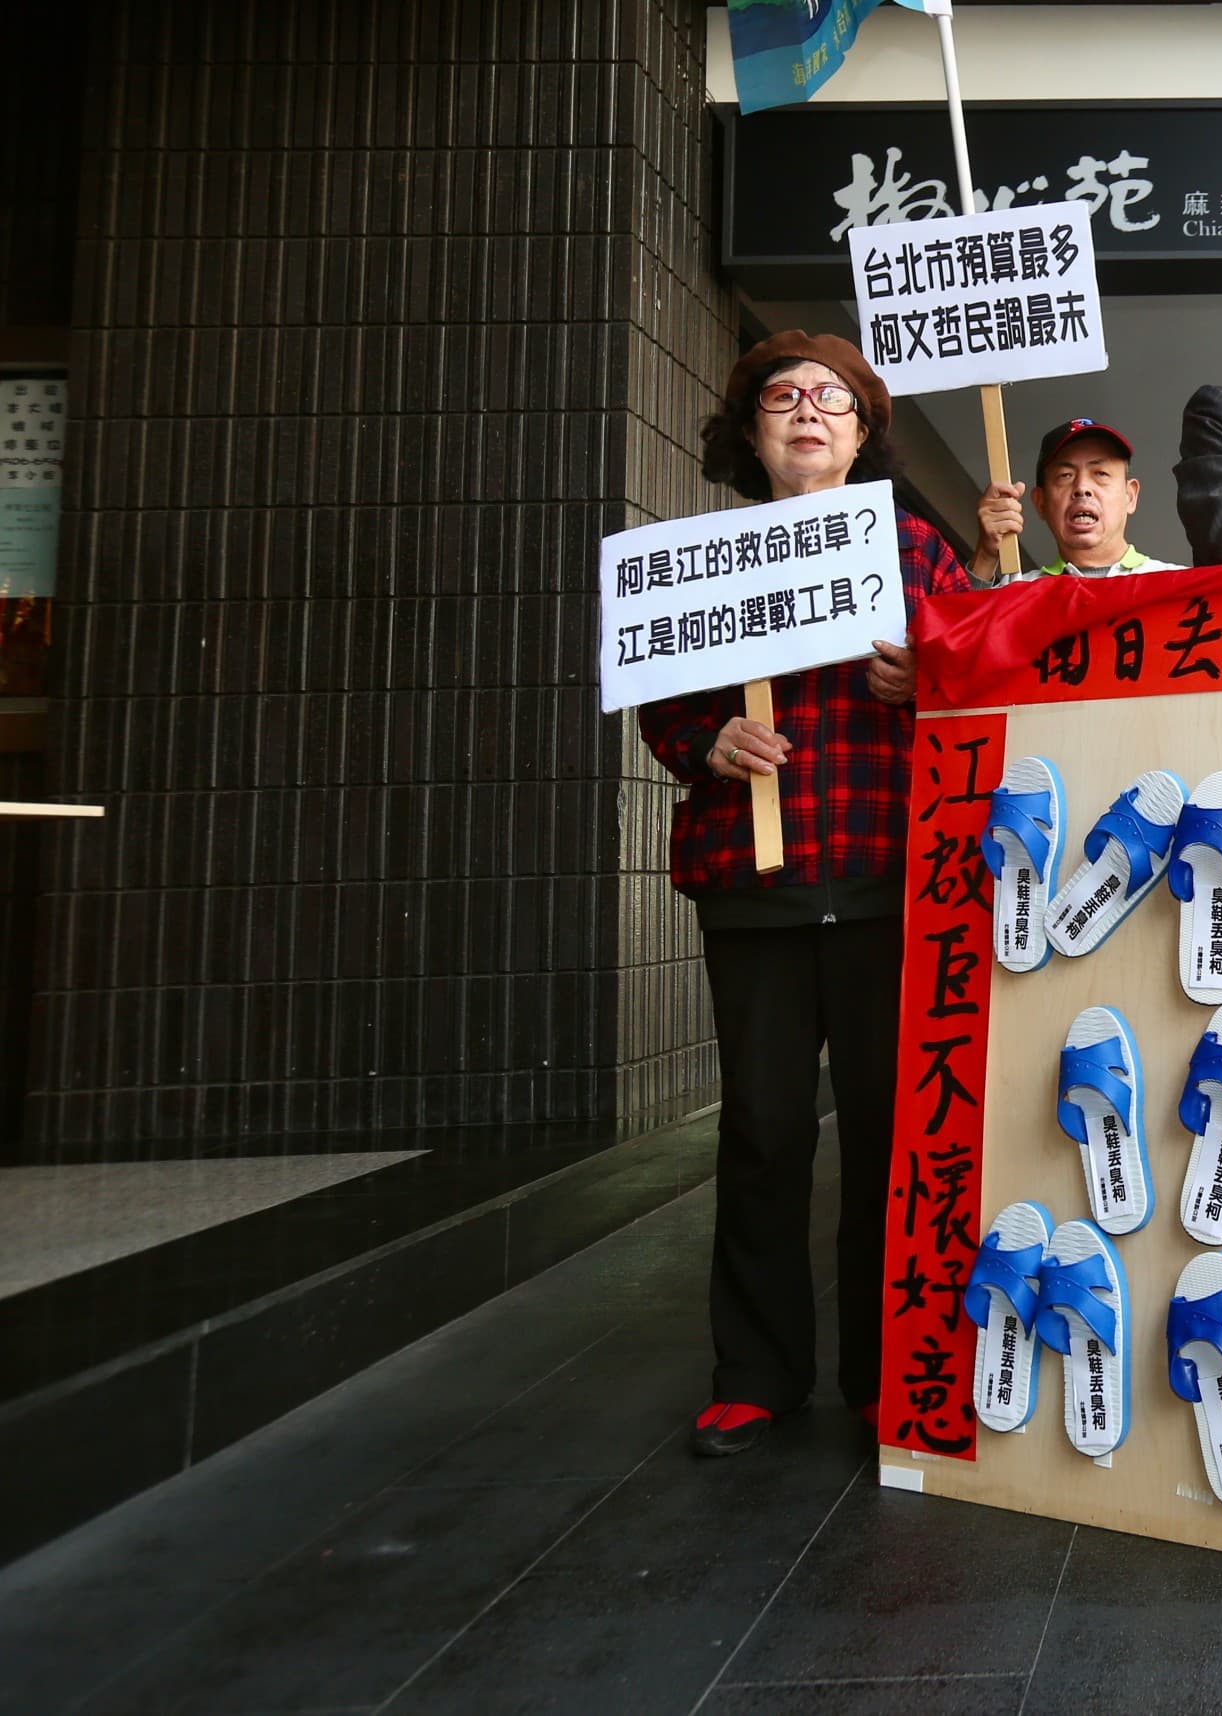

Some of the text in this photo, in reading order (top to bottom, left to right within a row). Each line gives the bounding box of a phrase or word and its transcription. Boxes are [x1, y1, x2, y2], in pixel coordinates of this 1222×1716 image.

[864, 223, 1079, 299] 台北市預算最多
[870, 291, 1089, 366] 柯文哲民調最末
[1014, 868, 1031, 950] 臭鞋丟臭柯
[1103, 1115, 1126, 1203] 臭鞋丟臭柯
[997, 1315, 1018, 1406] 臭鞋丟臭柯
[1086, 1339, 1106, 1430] 臭鞋丟臭柯
